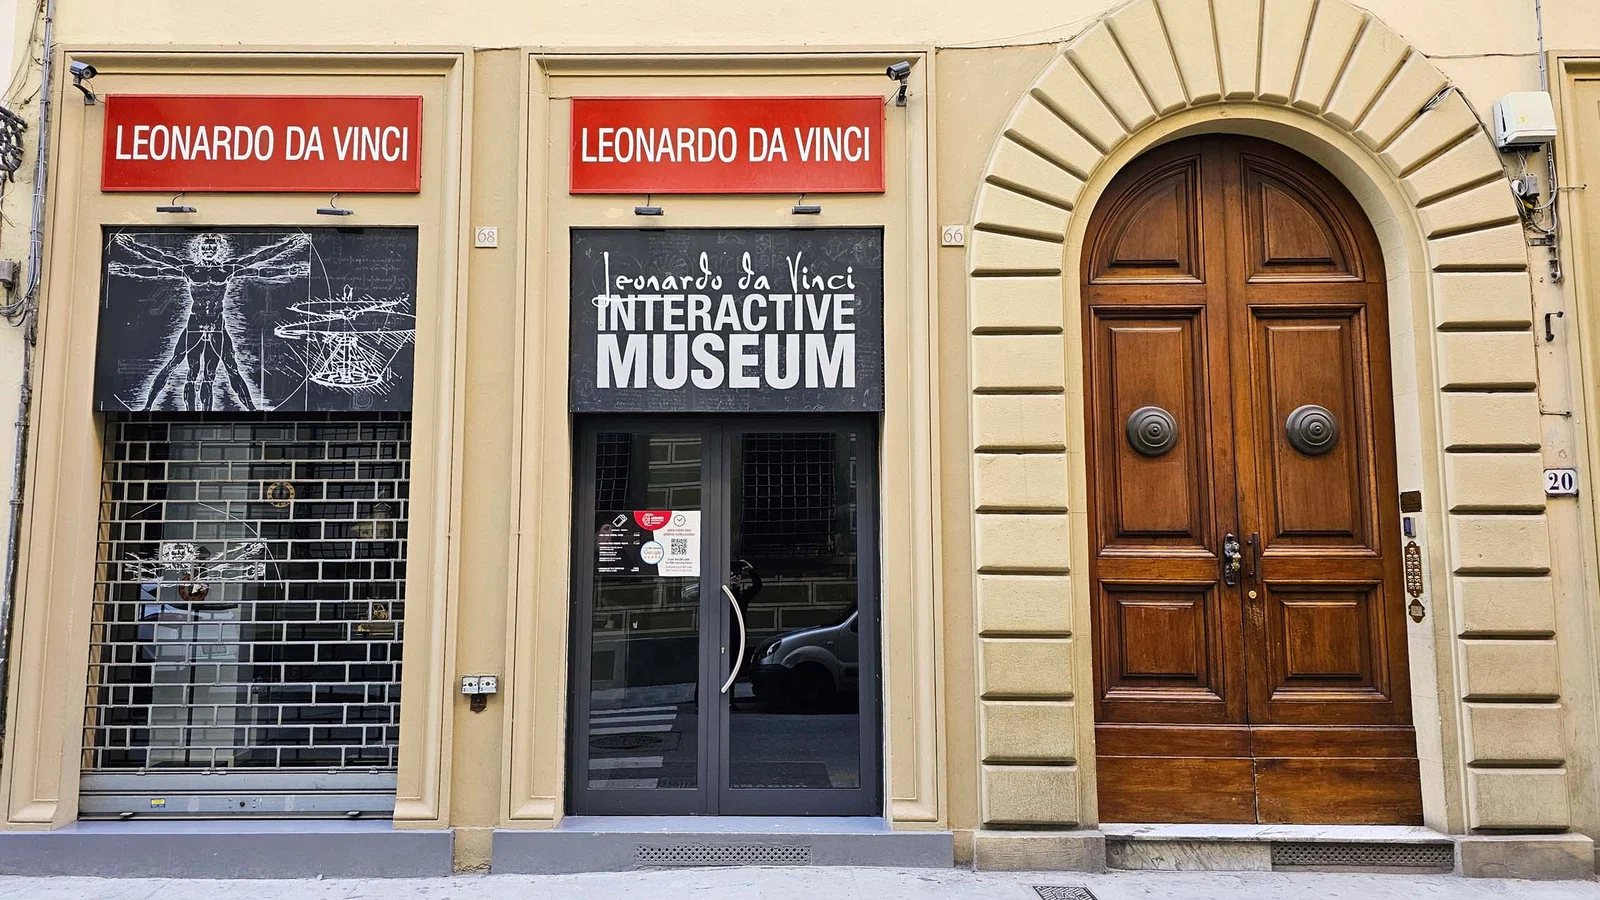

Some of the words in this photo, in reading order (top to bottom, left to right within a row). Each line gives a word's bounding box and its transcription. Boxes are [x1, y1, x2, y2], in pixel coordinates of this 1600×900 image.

[115, 124, 275, 162] LEONARDO
[285, 125, 325, 162] DA
[332, 125, 410, 163] VINCI
[581, 126, 738, 164] LEONARDO
[748, 127, 789, 164] DA
[793, 126, 870, 164] VINCI
[477, 228, 495, 243] 68
[943, 227, 963, 243] 66
[592, 251, 723, 308] Leonardo
[737, 251, 771, 290] da
[785, 250, 856, 292] Vinci
[597, 293, 856, 332] INTERACTIVE
[596, 332, 856, 390] MUSEUM
[1548, 472, 1573, 491] 20
